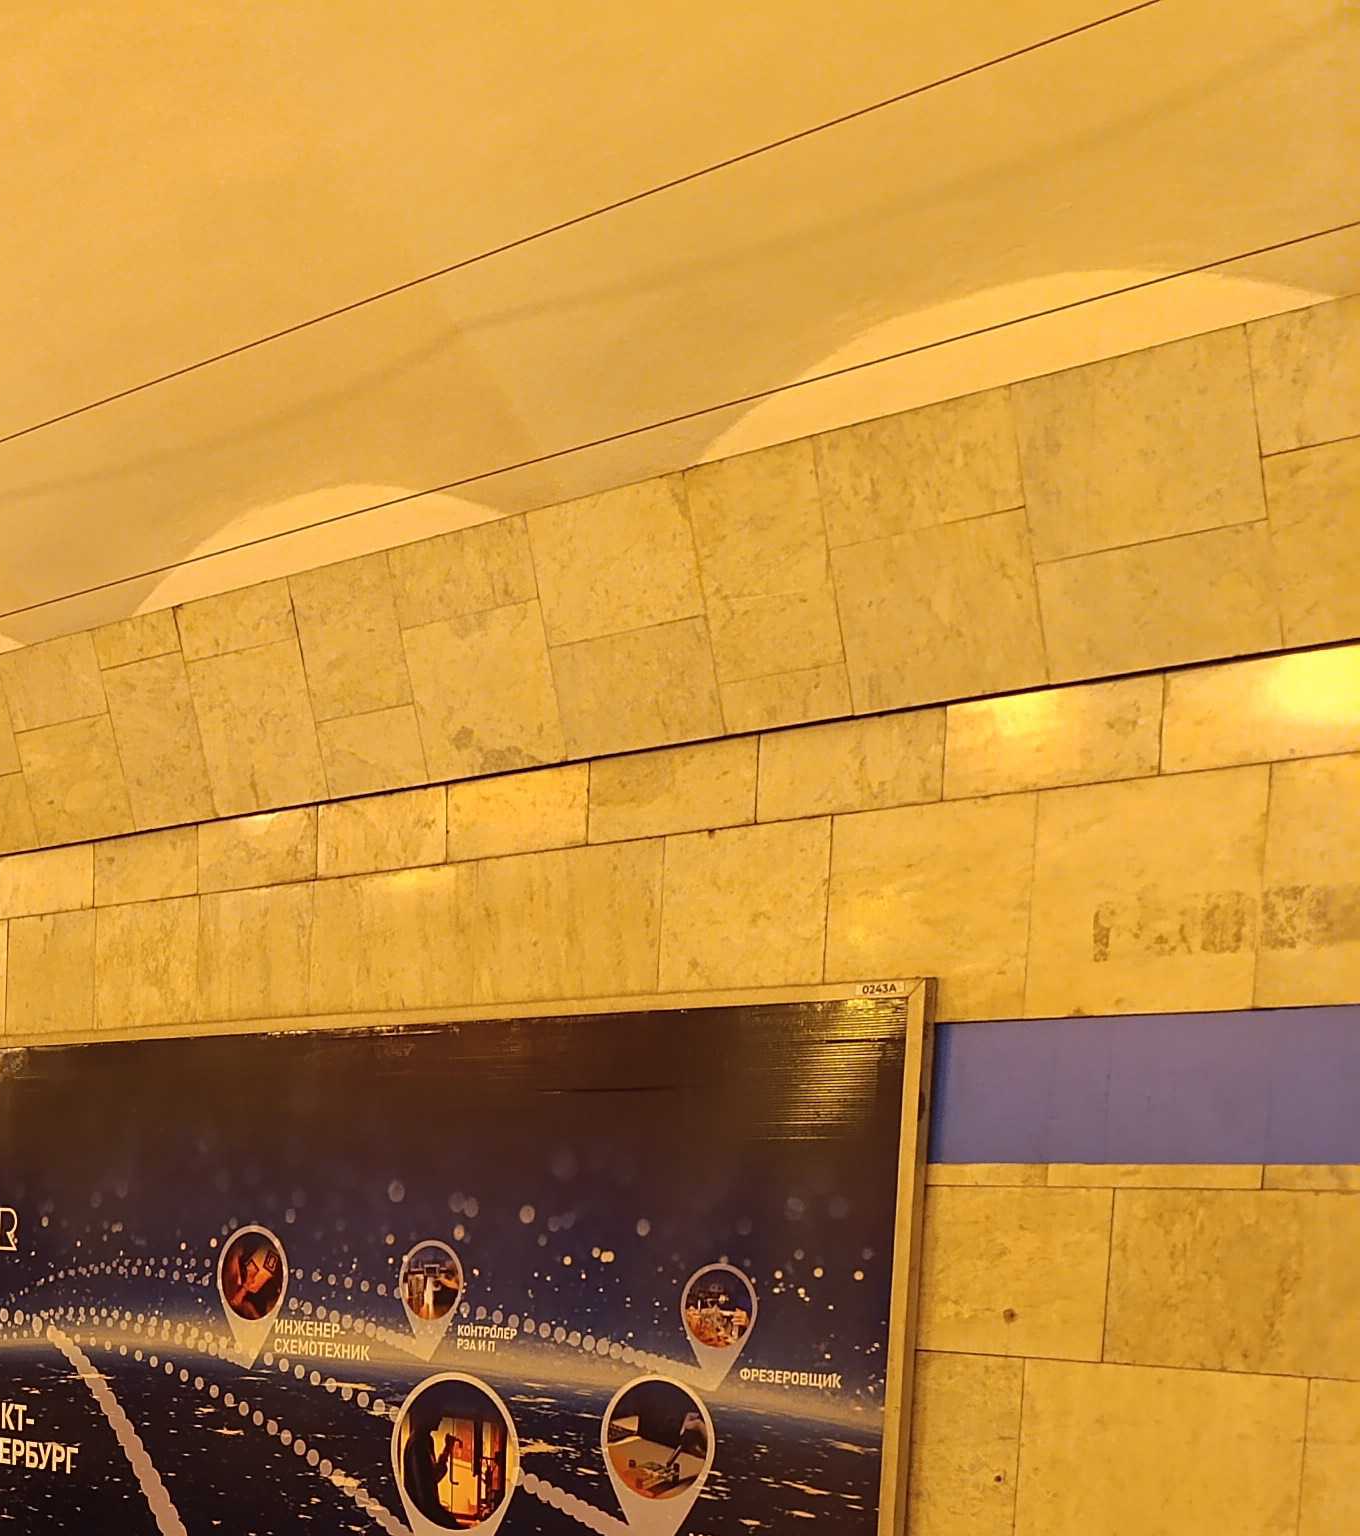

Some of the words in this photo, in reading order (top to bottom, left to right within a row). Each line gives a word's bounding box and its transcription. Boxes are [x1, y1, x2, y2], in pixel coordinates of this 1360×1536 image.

[274, 1319, 346, 1339] ИНЖЕНЕР-
[274, 1338, 370, 1361] СХЕМОТЕХНИК
[488, 1340, 495, 1352] П
[740, 1368, 842, 1389] ФРЕЗЕРОВЩИК
